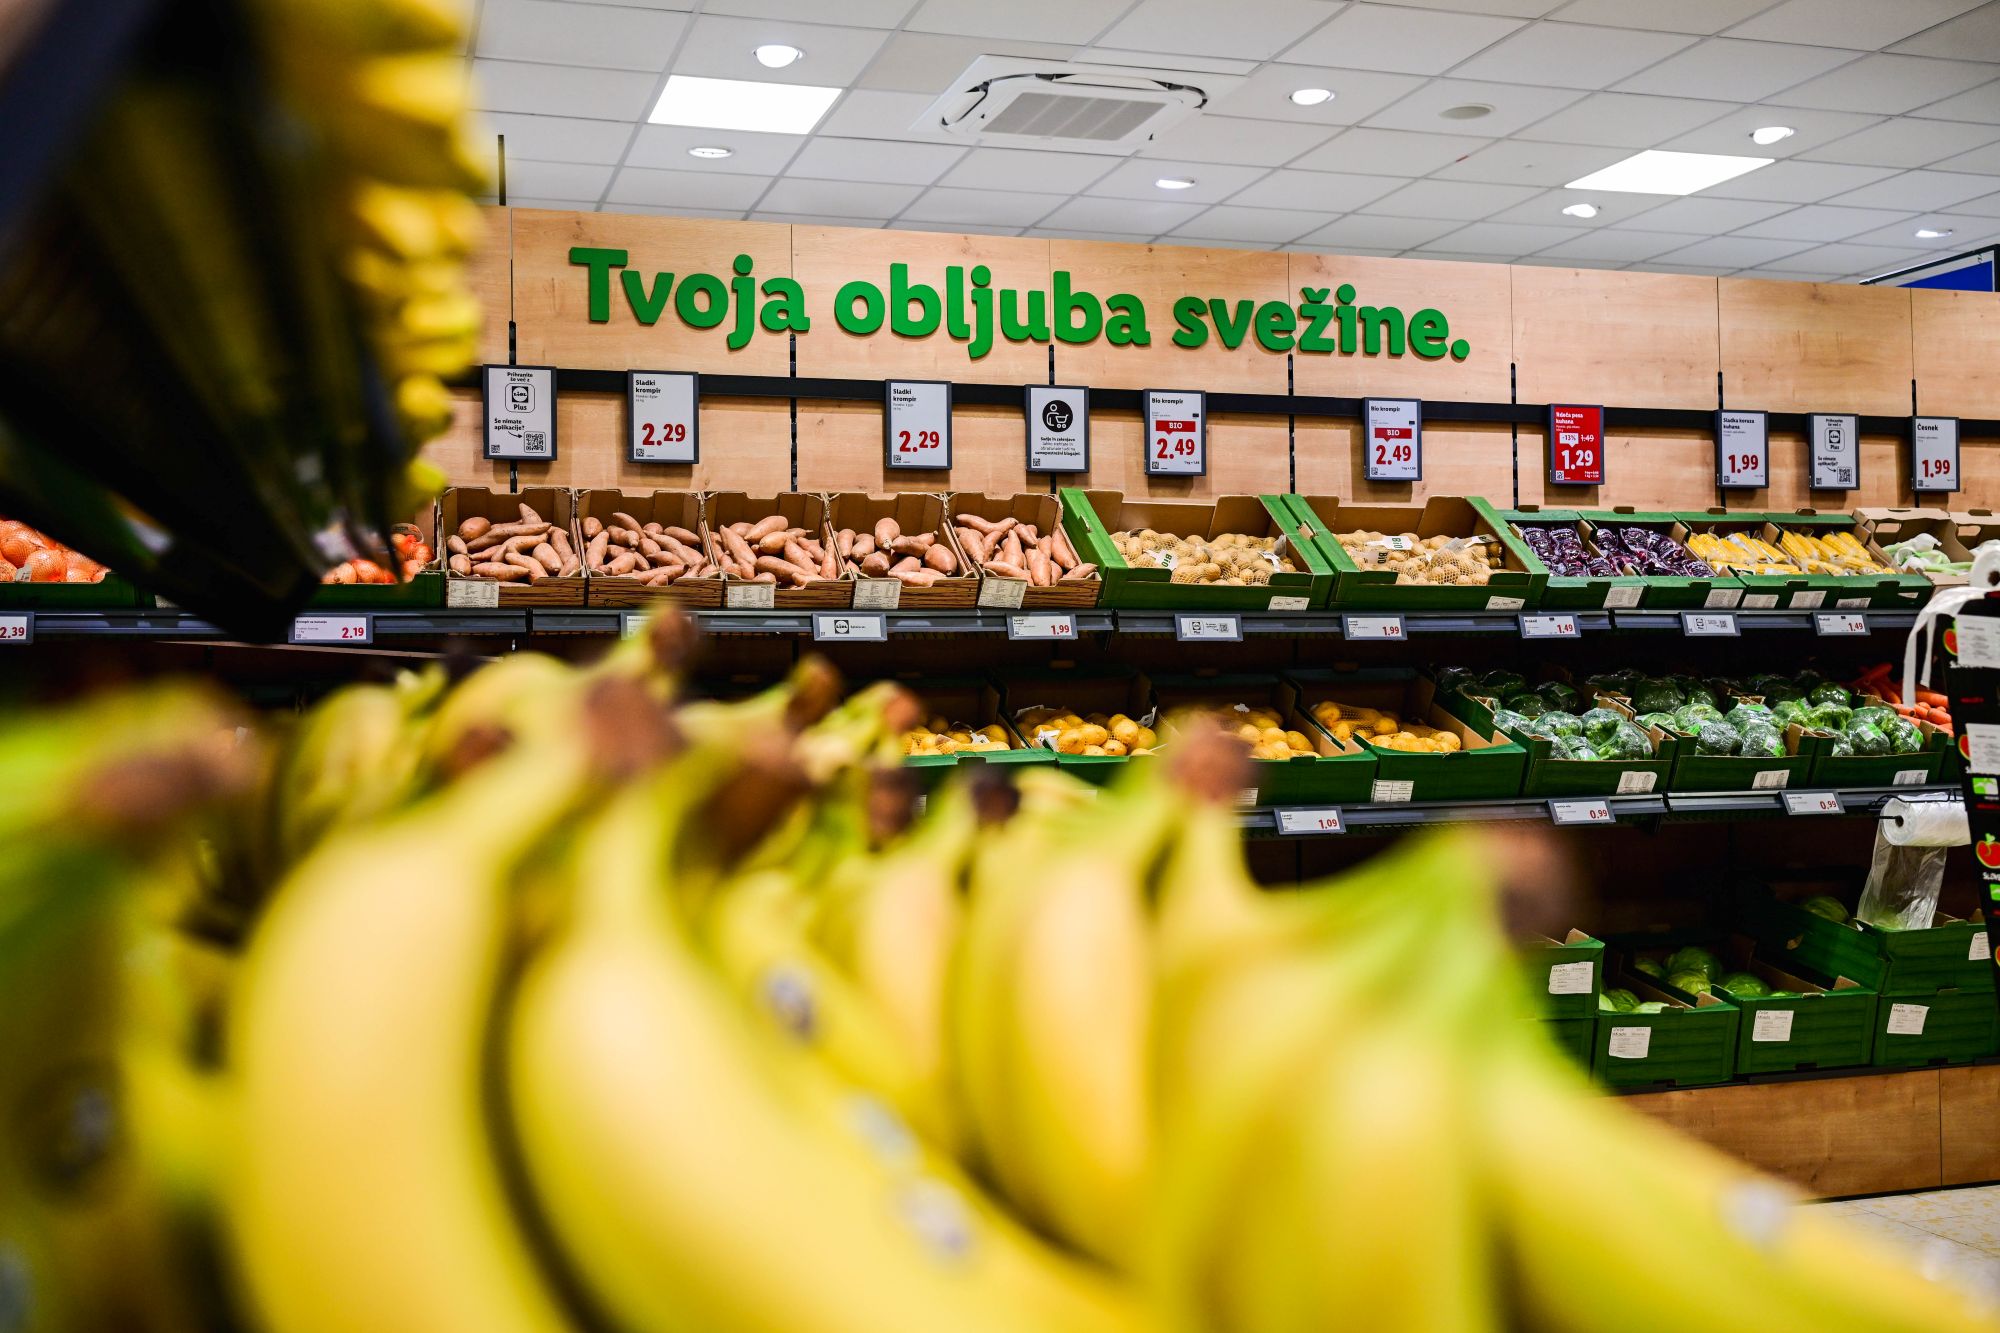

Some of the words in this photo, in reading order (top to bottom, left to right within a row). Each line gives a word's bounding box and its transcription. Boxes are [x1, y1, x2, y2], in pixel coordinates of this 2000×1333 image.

[568, 246, 810, 351] Tvoja
[834, 262, 1150, 360] obljuba
[1171, 283, 1471, 363] svežine.
[1917, 423, 1939, 431] Česnek
[642, 423, 686, 446] 2.29
[899, 430, 940, 453] 2.29
[1156, 438, 1195, 459] 2.49
[1375, 445, 1412, 465] 2.49
[1561, 449, 1594, 470] 1.29
[1728, 454, 1759, 474] 1.99
[1922, 459, 1951, 478] 1.99
[0, 626, 25, 638] 2.39
[341, 627, 364, 639] 2.19
[1051, 624, 1070, 635] 1.99
[1382, 626, 1400, 636] 1.99
[1557, 623, 1574, 634] 1.49
[1848, 622, 1864, 632] 1.49
[1820, 800, 1837, 810] 0.99
[1589, 809, 1608, 819] 0.99
[1318, 818, 1338, 830] 1.09
